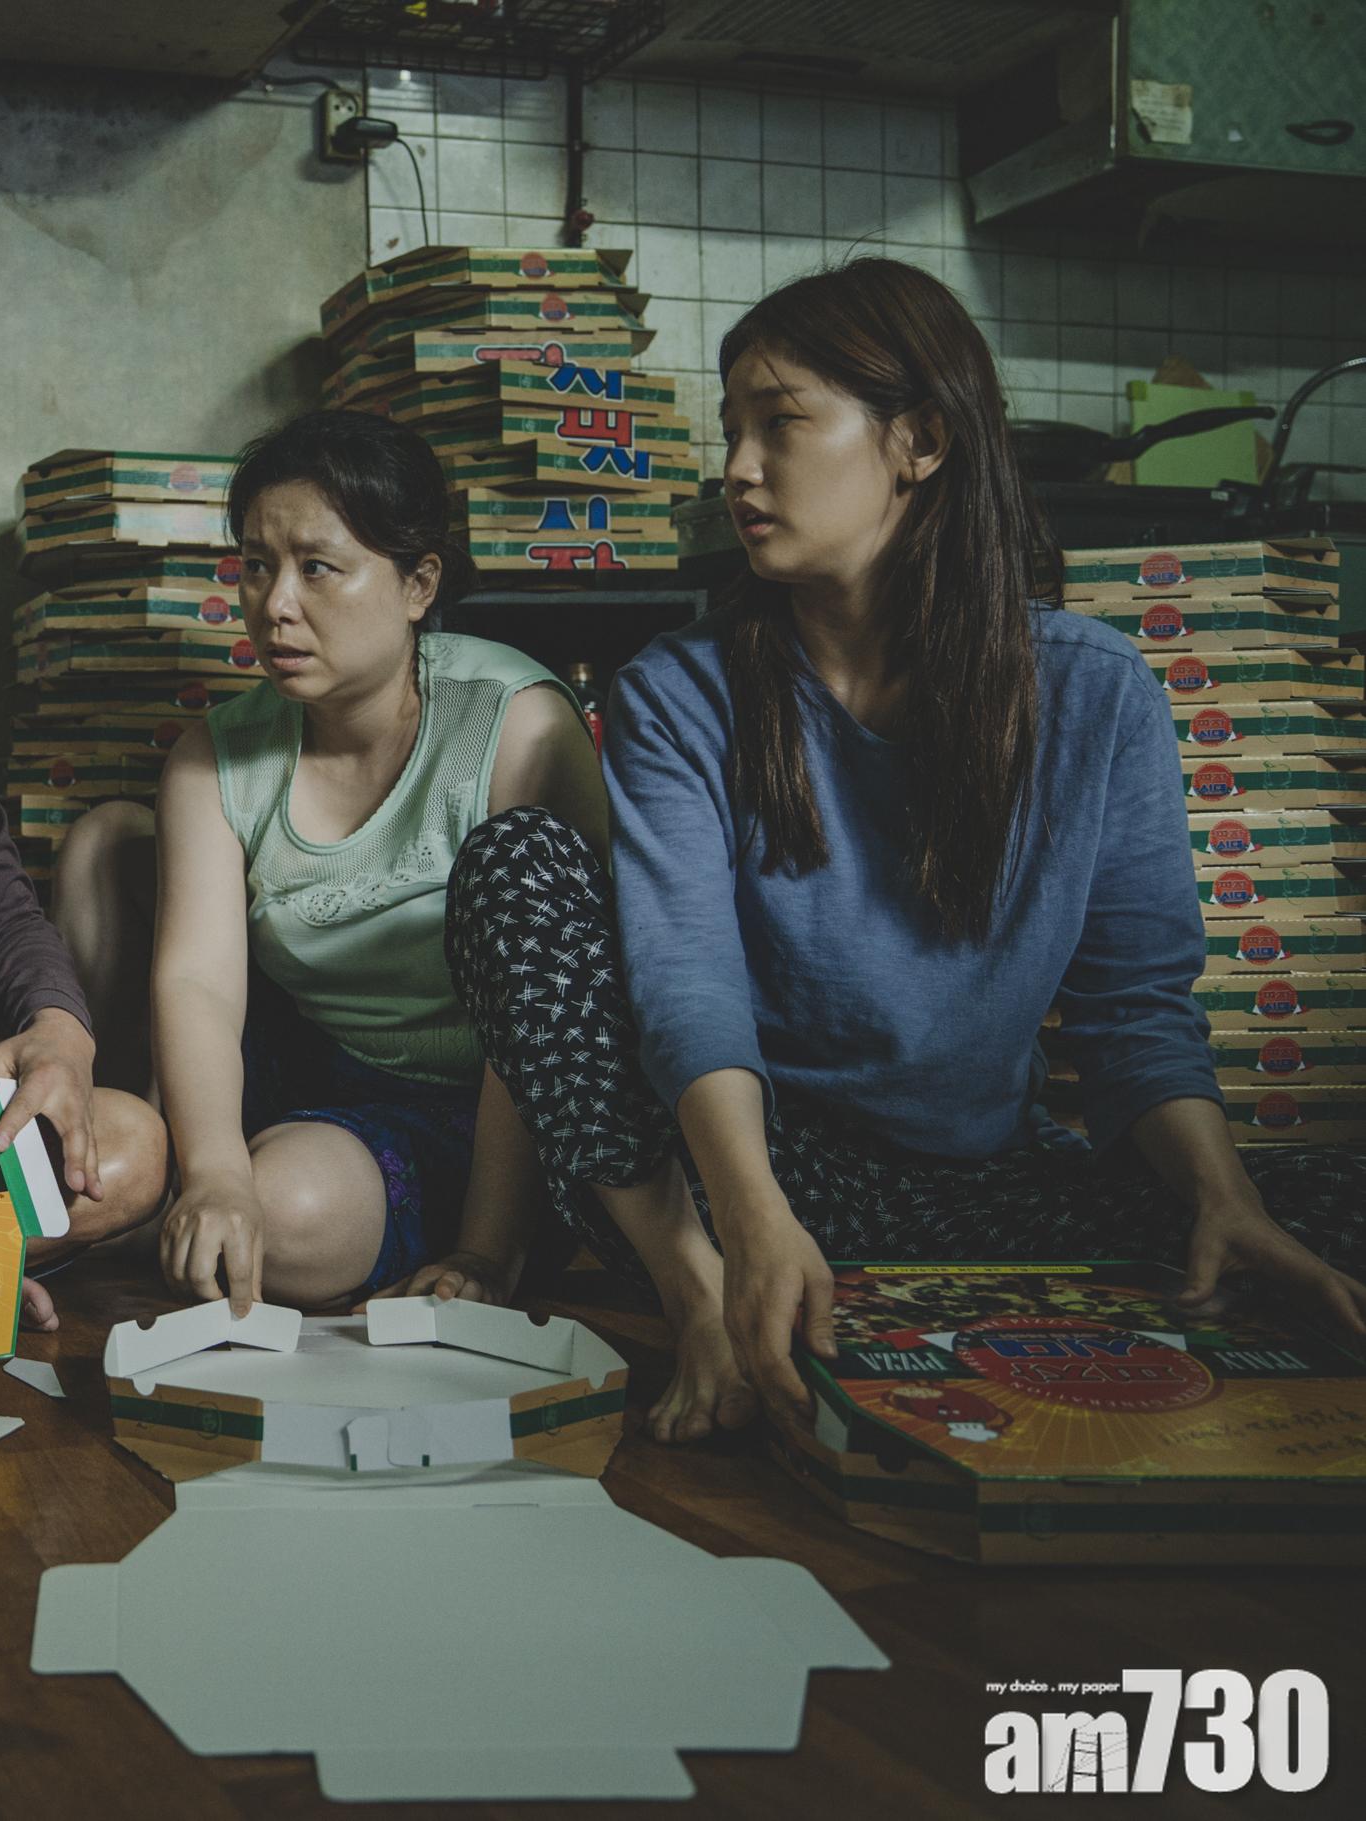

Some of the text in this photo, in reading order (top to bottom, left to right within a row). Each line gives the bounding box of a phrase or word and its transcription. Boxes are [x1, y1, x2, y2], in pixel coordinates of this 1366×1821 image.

[984, 1338, 1137, 1358] 시대
[857, 1352, 948, 1372] PIZZA
[1214, 1351, 1311, 1370] ITALY
[1010, 1362, 1187, 1383] 피자
